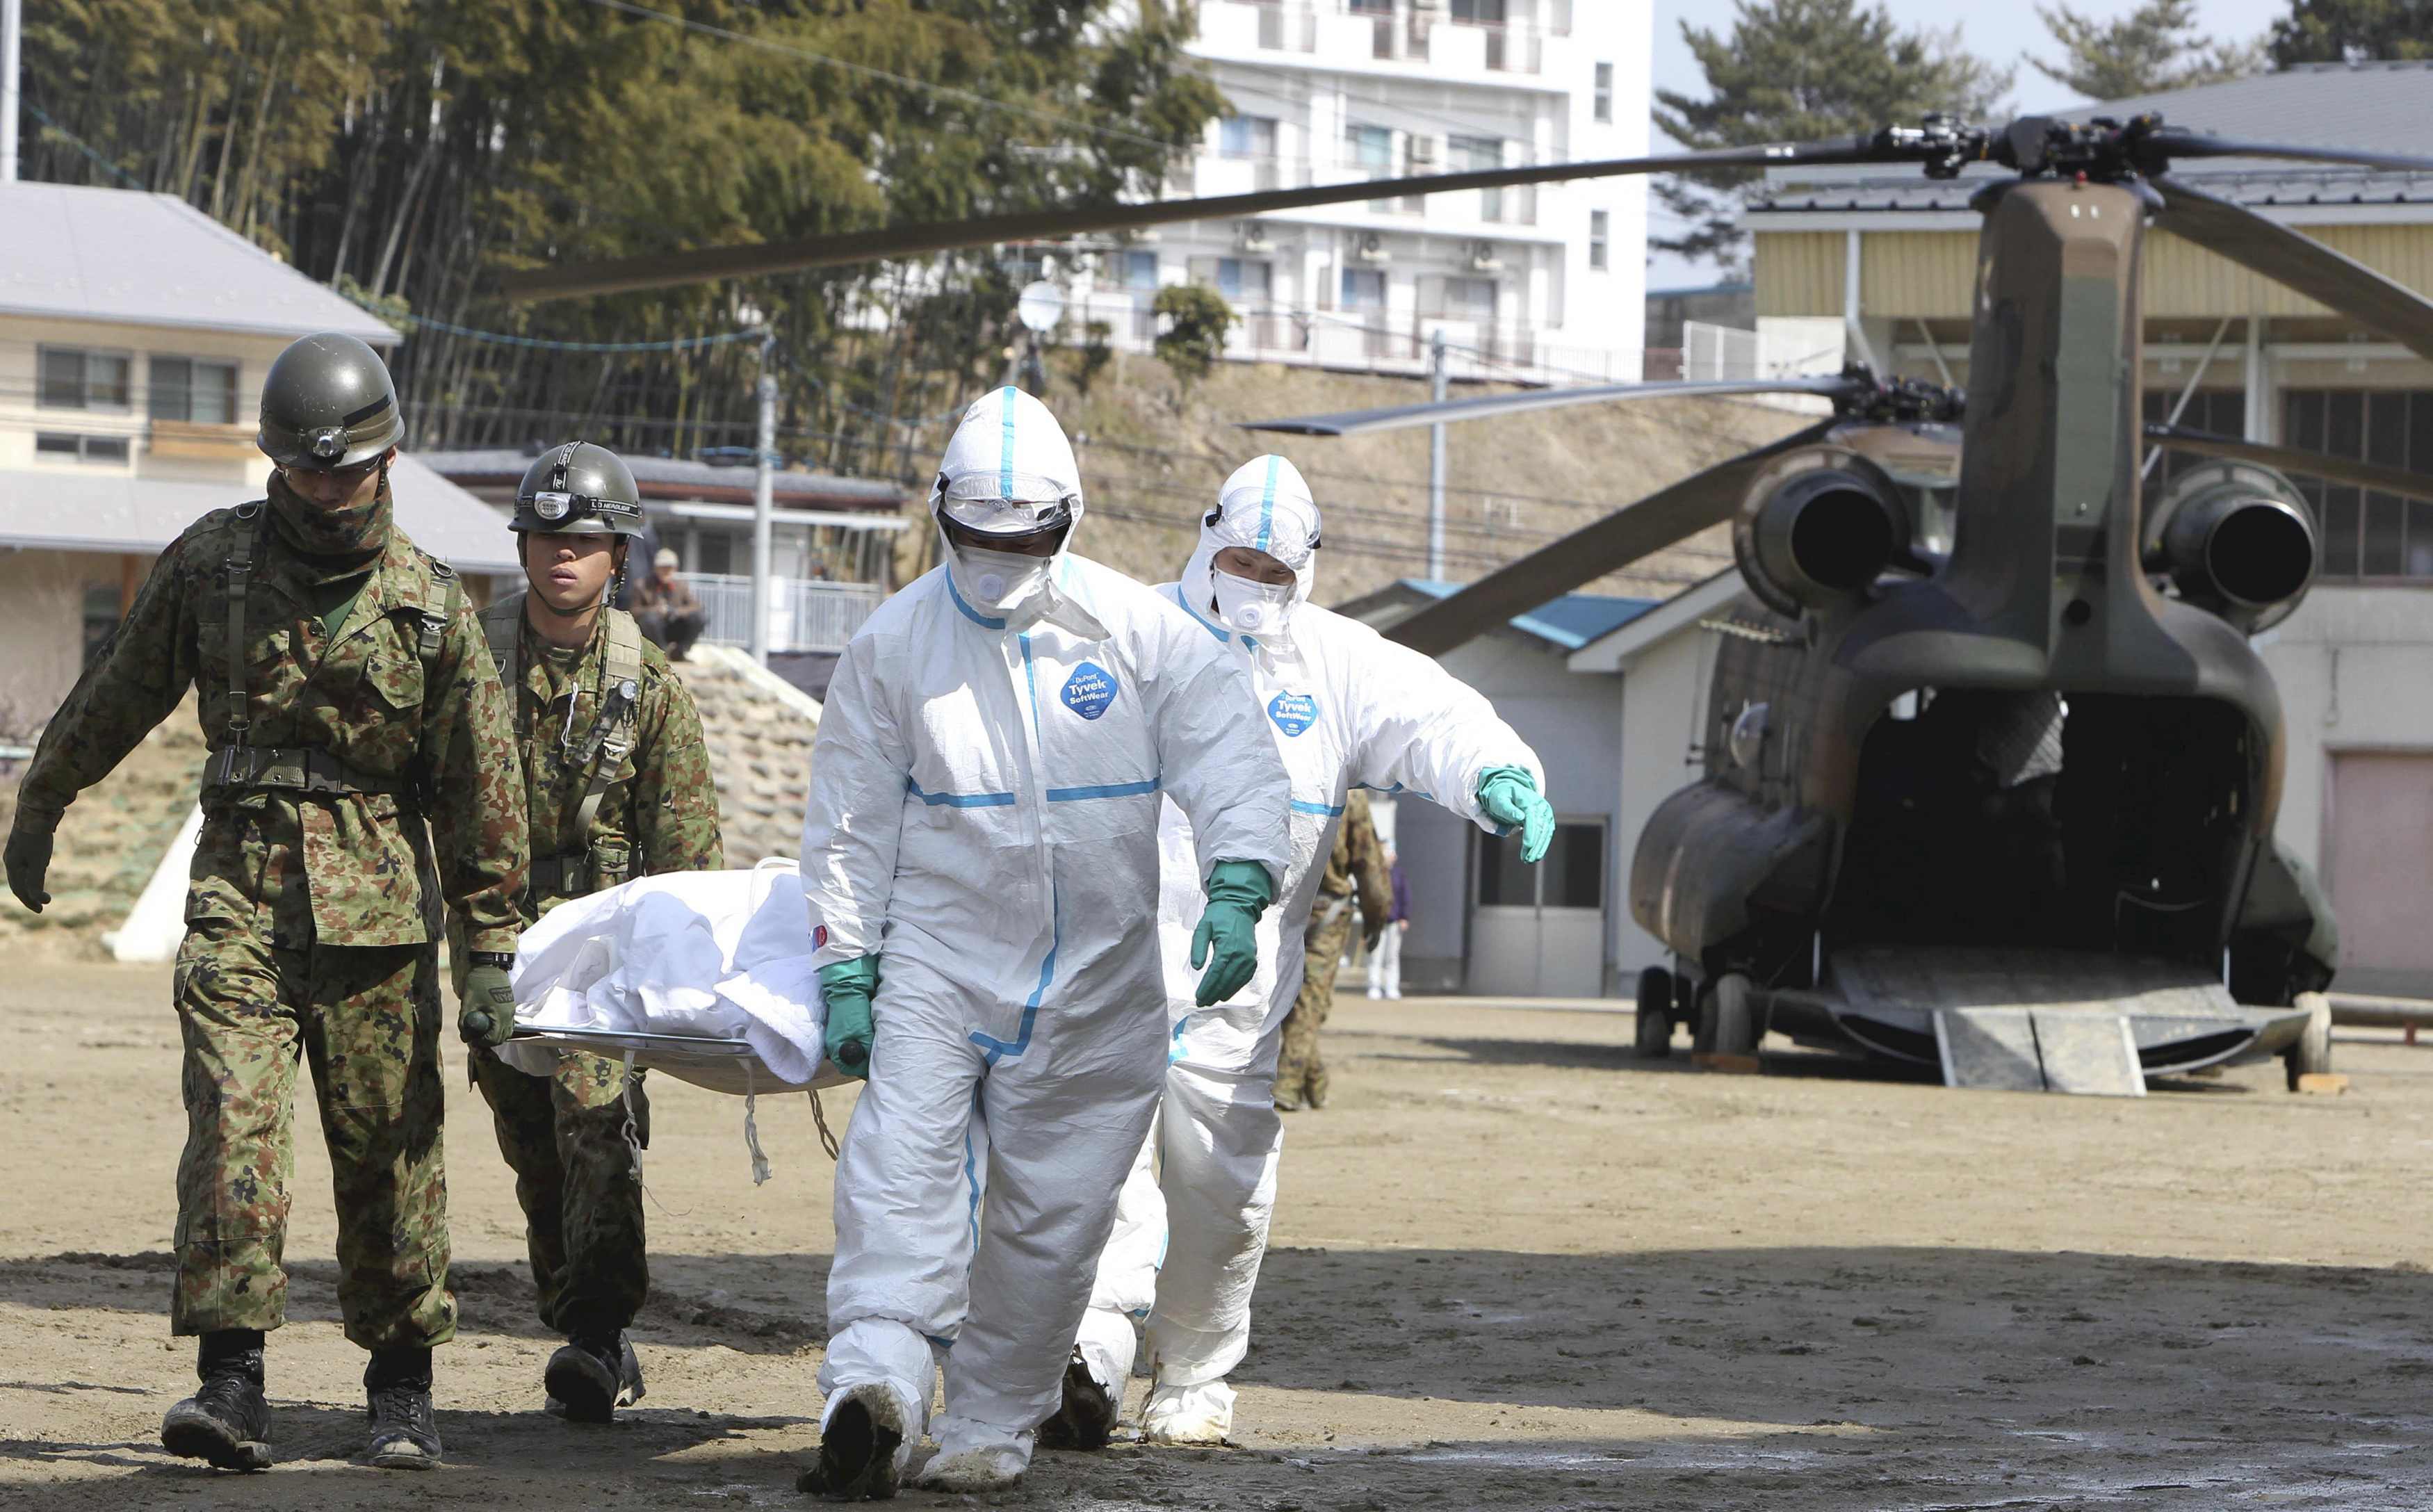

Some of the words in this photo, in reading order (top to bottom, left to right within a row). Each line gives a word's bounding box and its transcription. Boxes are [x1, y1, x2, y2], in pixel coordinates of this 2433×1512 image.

[1068, 680, 1107, 695] Tyvek
[1069, 692, 1108, 704] SoftWear
[1278, 700, 1312, 713] Tyvek
[1276, 711, 1312, 720] SoftWear
